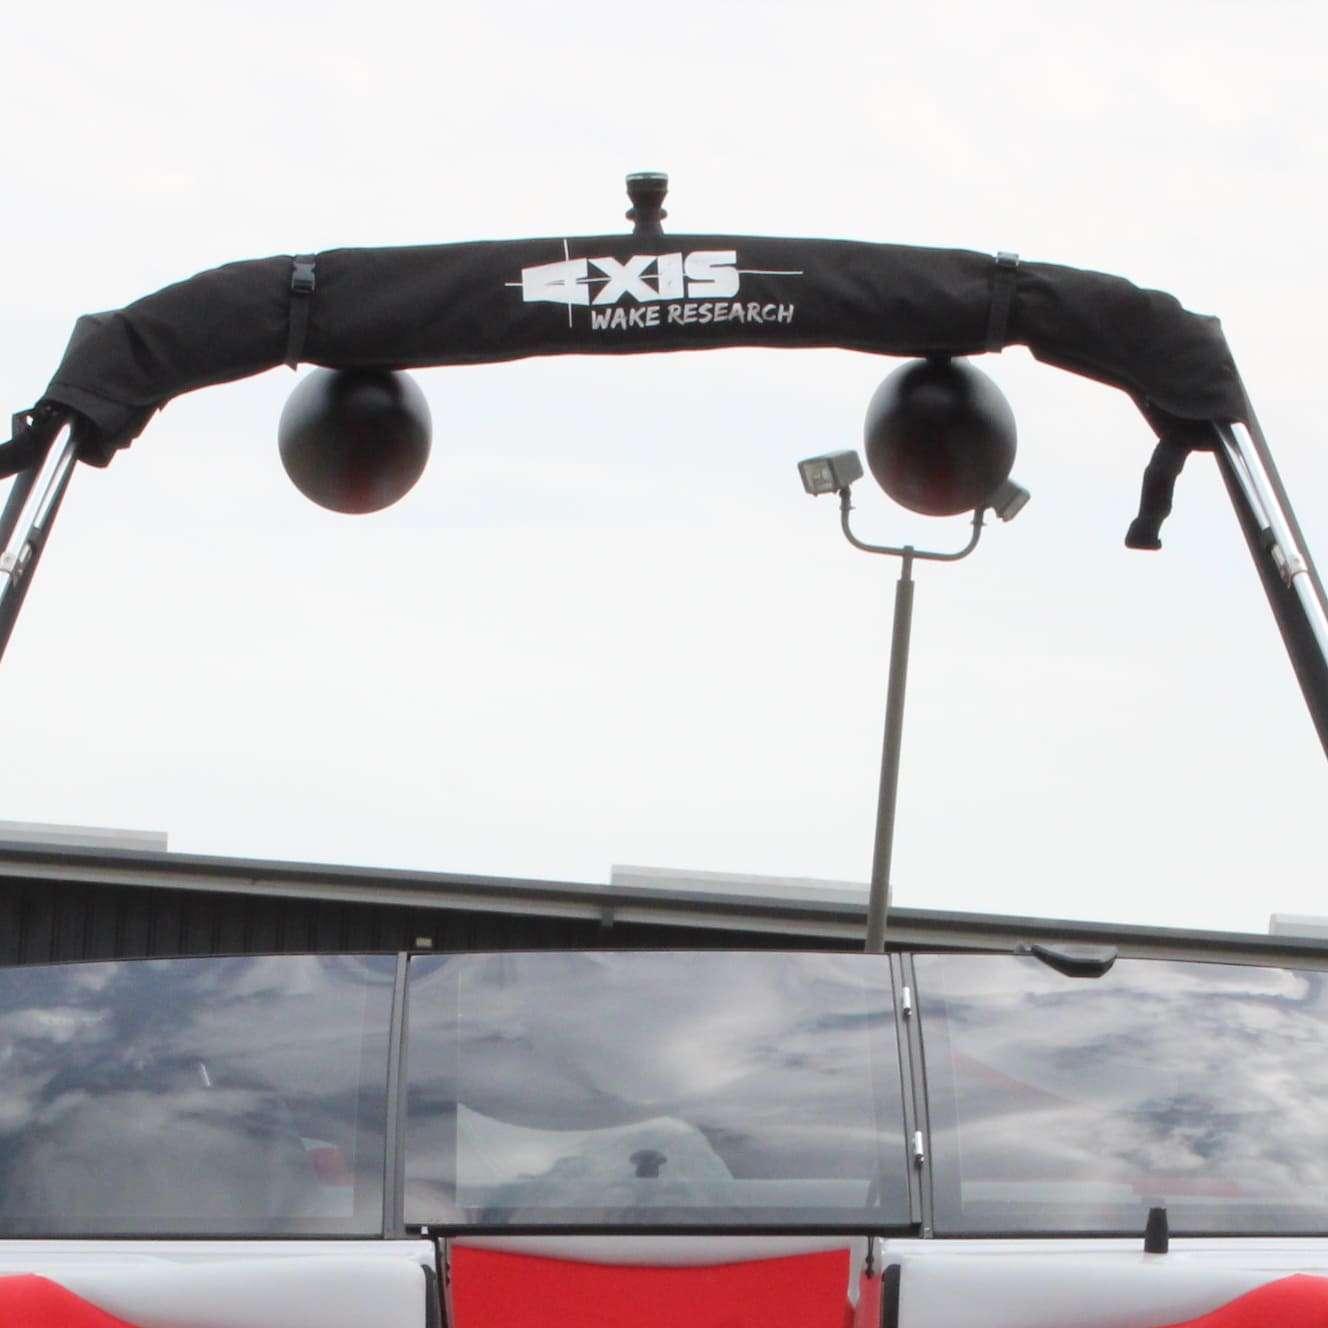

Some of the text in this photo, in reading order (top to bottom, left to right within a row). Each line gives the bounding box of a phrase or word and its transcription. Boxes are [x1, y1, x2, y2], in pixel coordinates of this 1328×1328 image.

[521, 250, 740, 305] AXIS
[591, 302, 795, 331] WAKE RESEARCH
